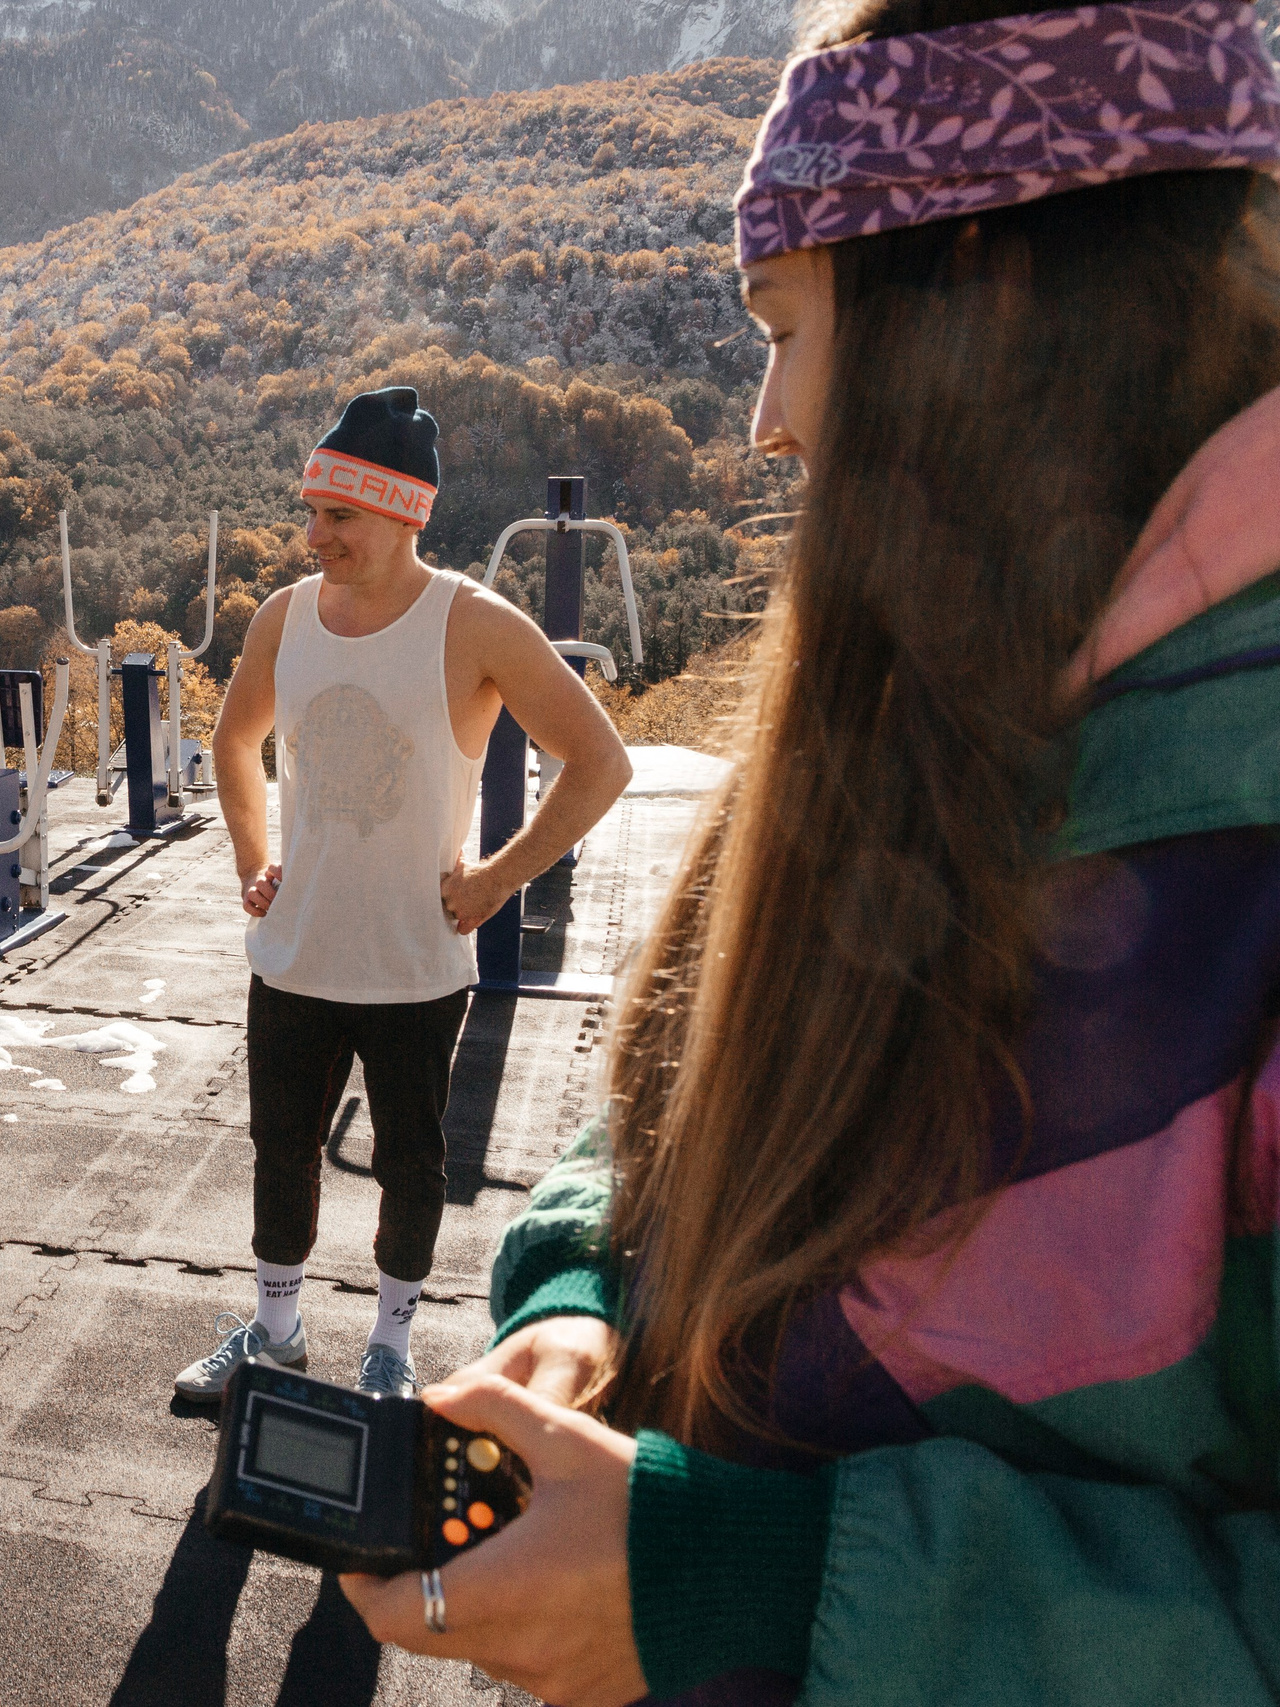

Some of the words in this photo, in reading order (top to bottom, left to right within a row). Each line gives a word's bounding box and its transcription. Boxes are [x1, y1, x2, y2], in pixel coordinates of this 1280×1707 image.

[263, 1279, 287, 1288] WALK
[266, 1290, 282, 1298] EAT
[283, 1288, 299, 1298] HAR
